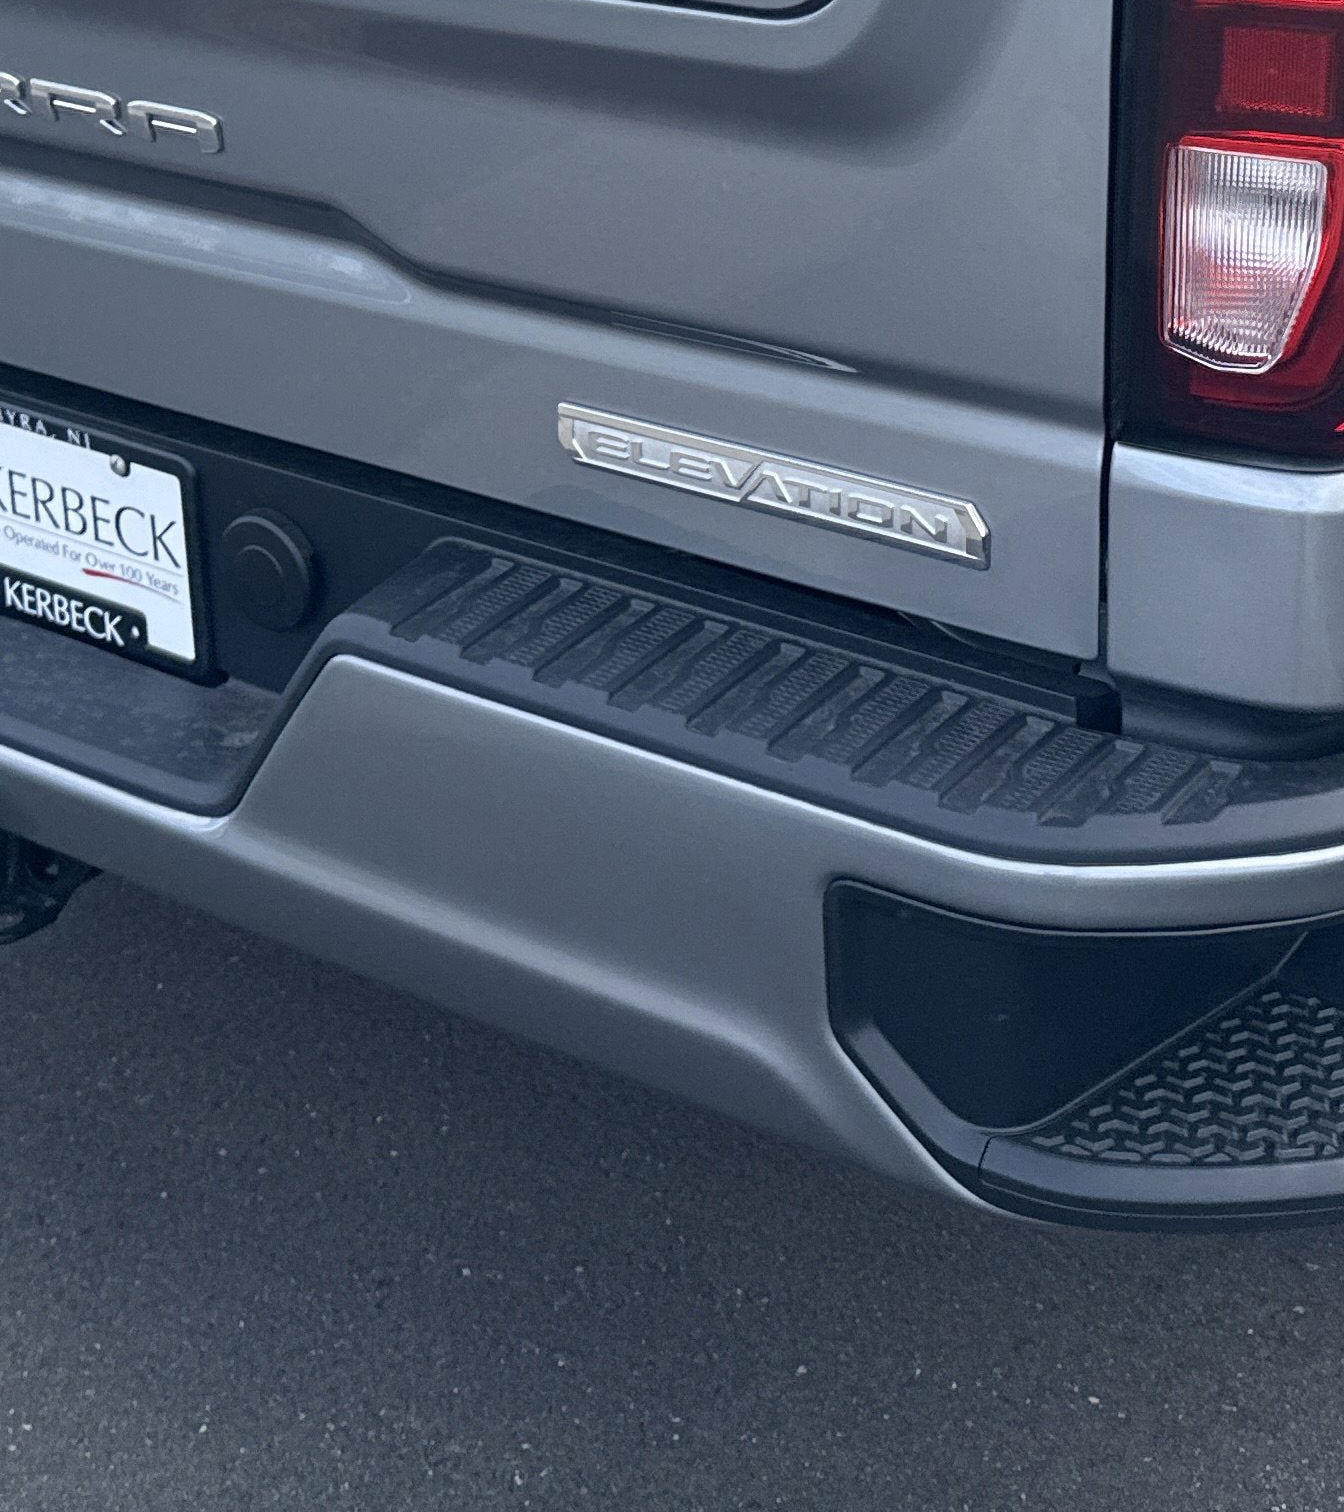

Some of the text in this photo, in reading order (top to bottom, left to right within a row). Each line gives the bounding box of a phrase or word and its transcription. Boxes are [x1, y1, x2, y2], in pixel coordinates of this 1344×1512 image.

[588, 431, 952, 543] ELEVATION
[3, 524, 60, 556] Operated
[62, 545, 82, 562] For
[85, 552, 116, 571] Over
[120, 564, 143, 582] 100
[146, 571, 180, 595] Years
[3, 576, 126, 647] KERBECK
